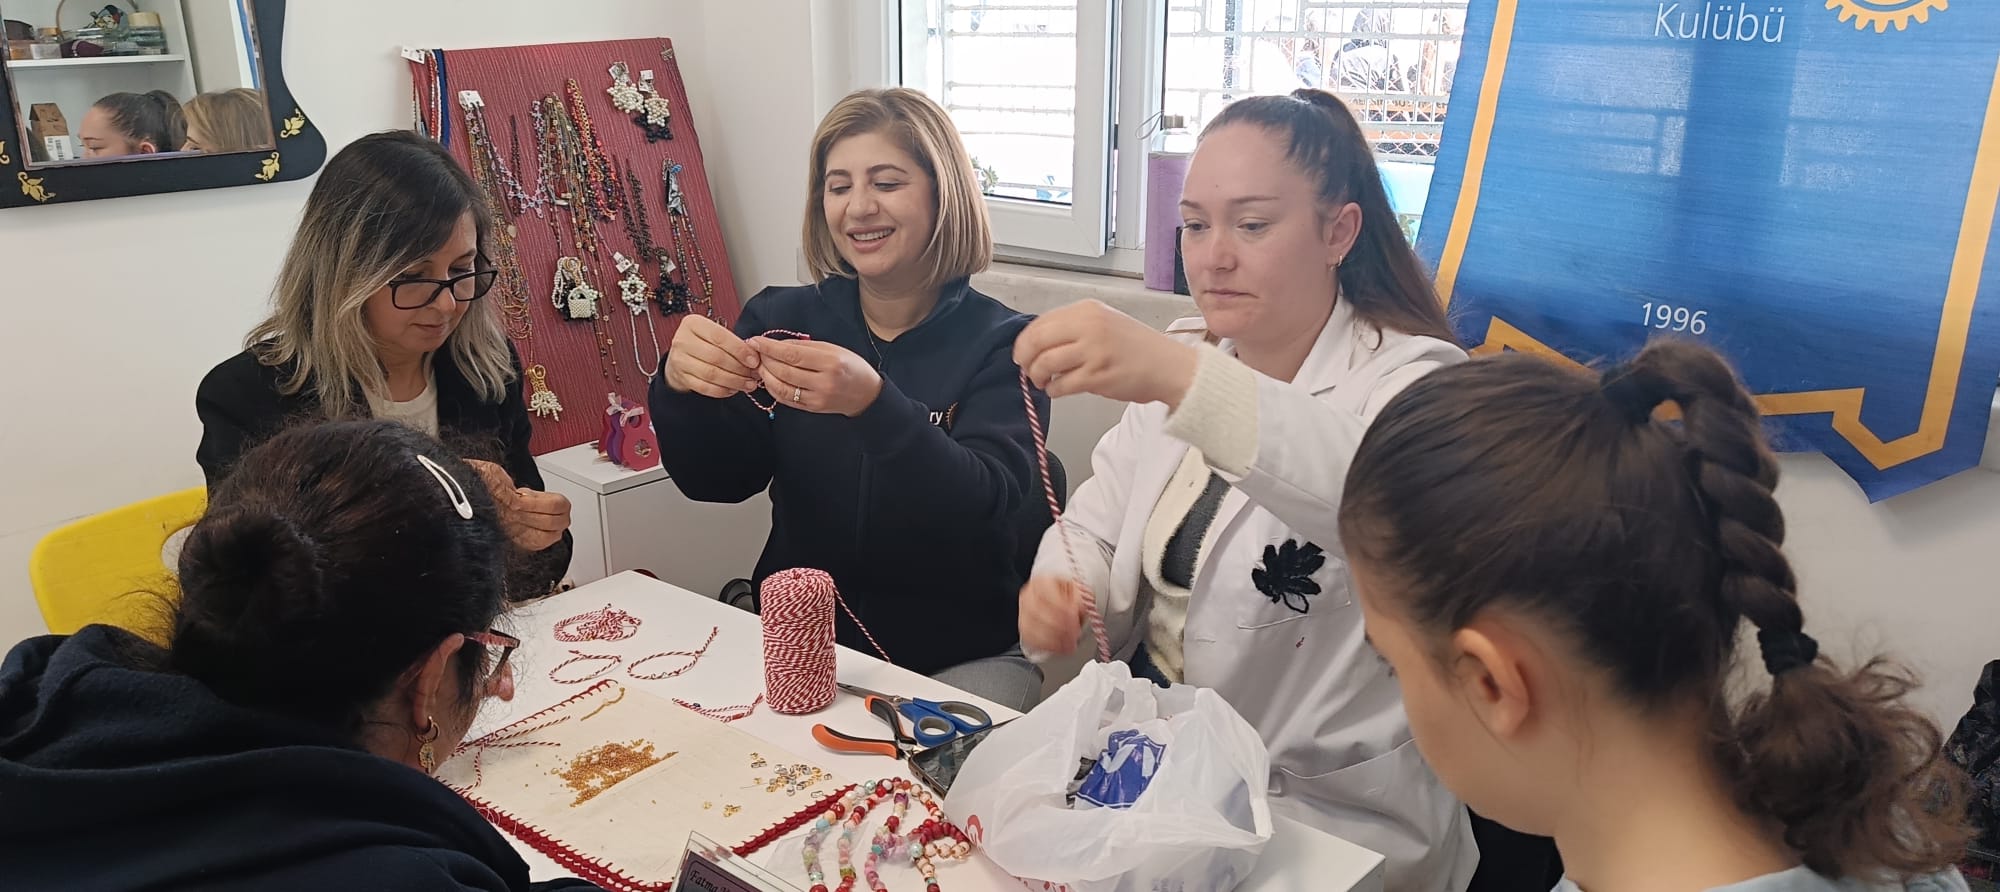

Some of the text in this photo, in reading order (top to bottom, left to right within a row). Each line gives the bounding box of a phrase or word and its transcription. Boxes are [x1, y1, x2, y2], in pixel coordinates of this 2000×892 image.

[1654, 1, 1785, 43] Kulübü
[1642, 302, 1708, 335] 1996
[929, 411, 944, 426] ry
[690, 870, 719, 892] Fatma
